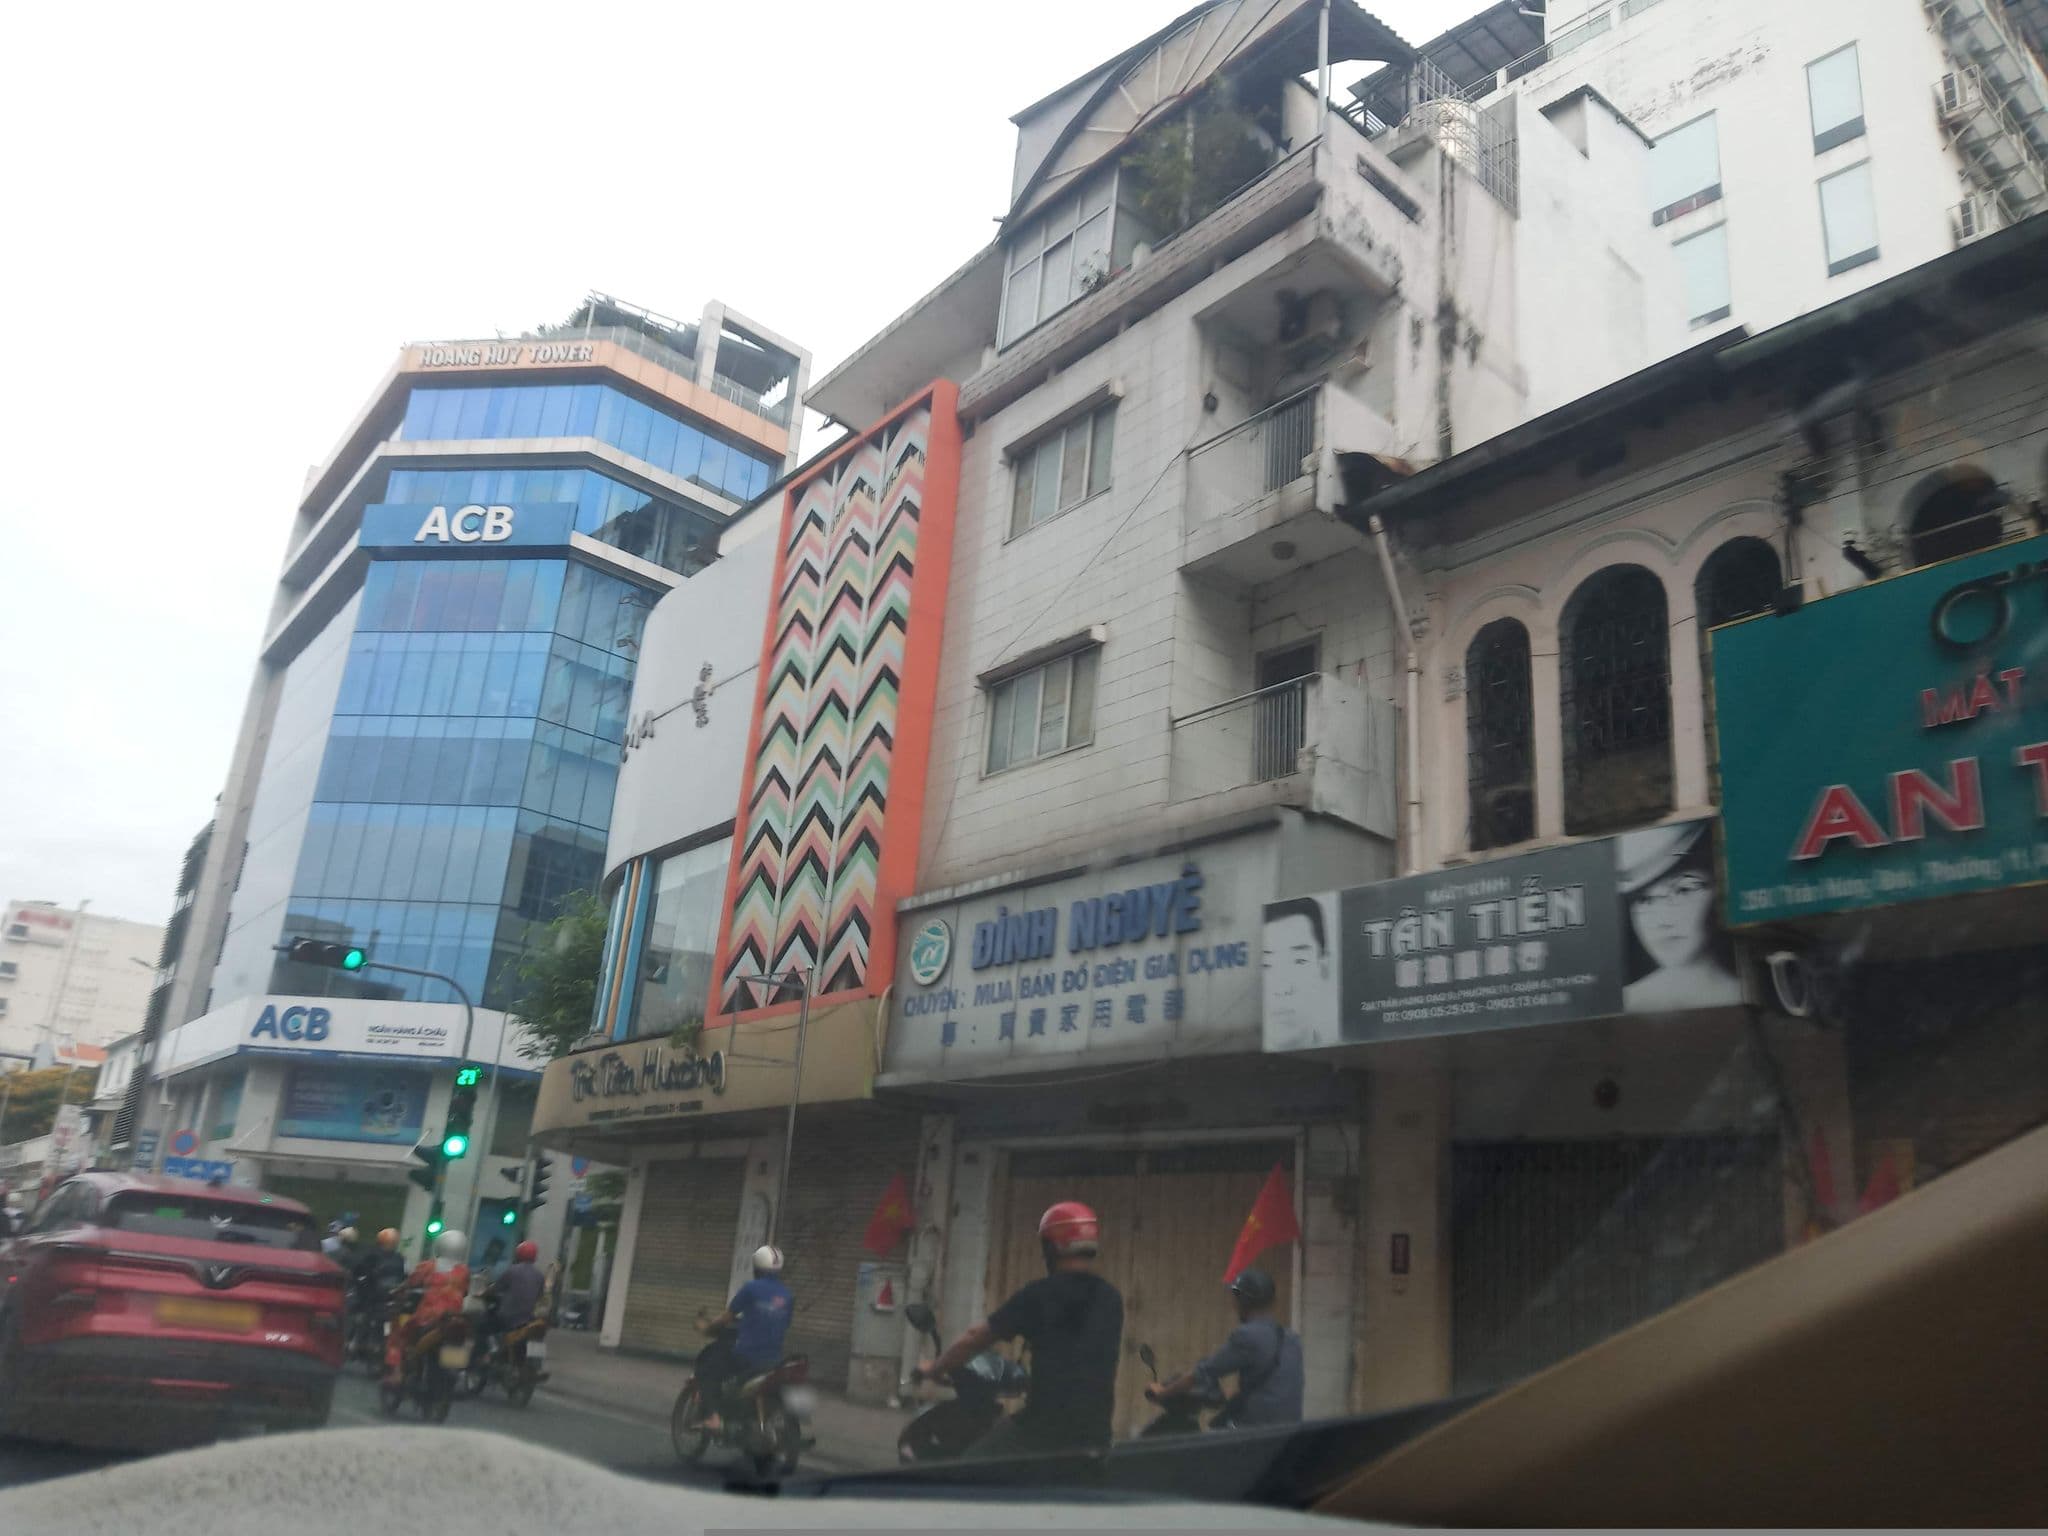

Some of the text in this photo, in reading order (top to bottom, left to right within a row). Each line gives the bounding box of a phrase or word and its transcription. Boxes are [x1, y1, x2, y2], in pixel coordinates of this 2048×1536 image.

[485, 346, 523, 365] HUY
[529, 344, 594, 364] TOWER
[415, 505, 515, 543] ACB
[1788, 756, 1985, 861] AN
[1362, 905, 1456, 959] TÂN
[974, 984, 1015, 1009] MUA
[1019, 969, 1056, 999] BÁN
[1144, 949, 1180, 981] GIA
[251, 1005, 330, 1041] ACB
